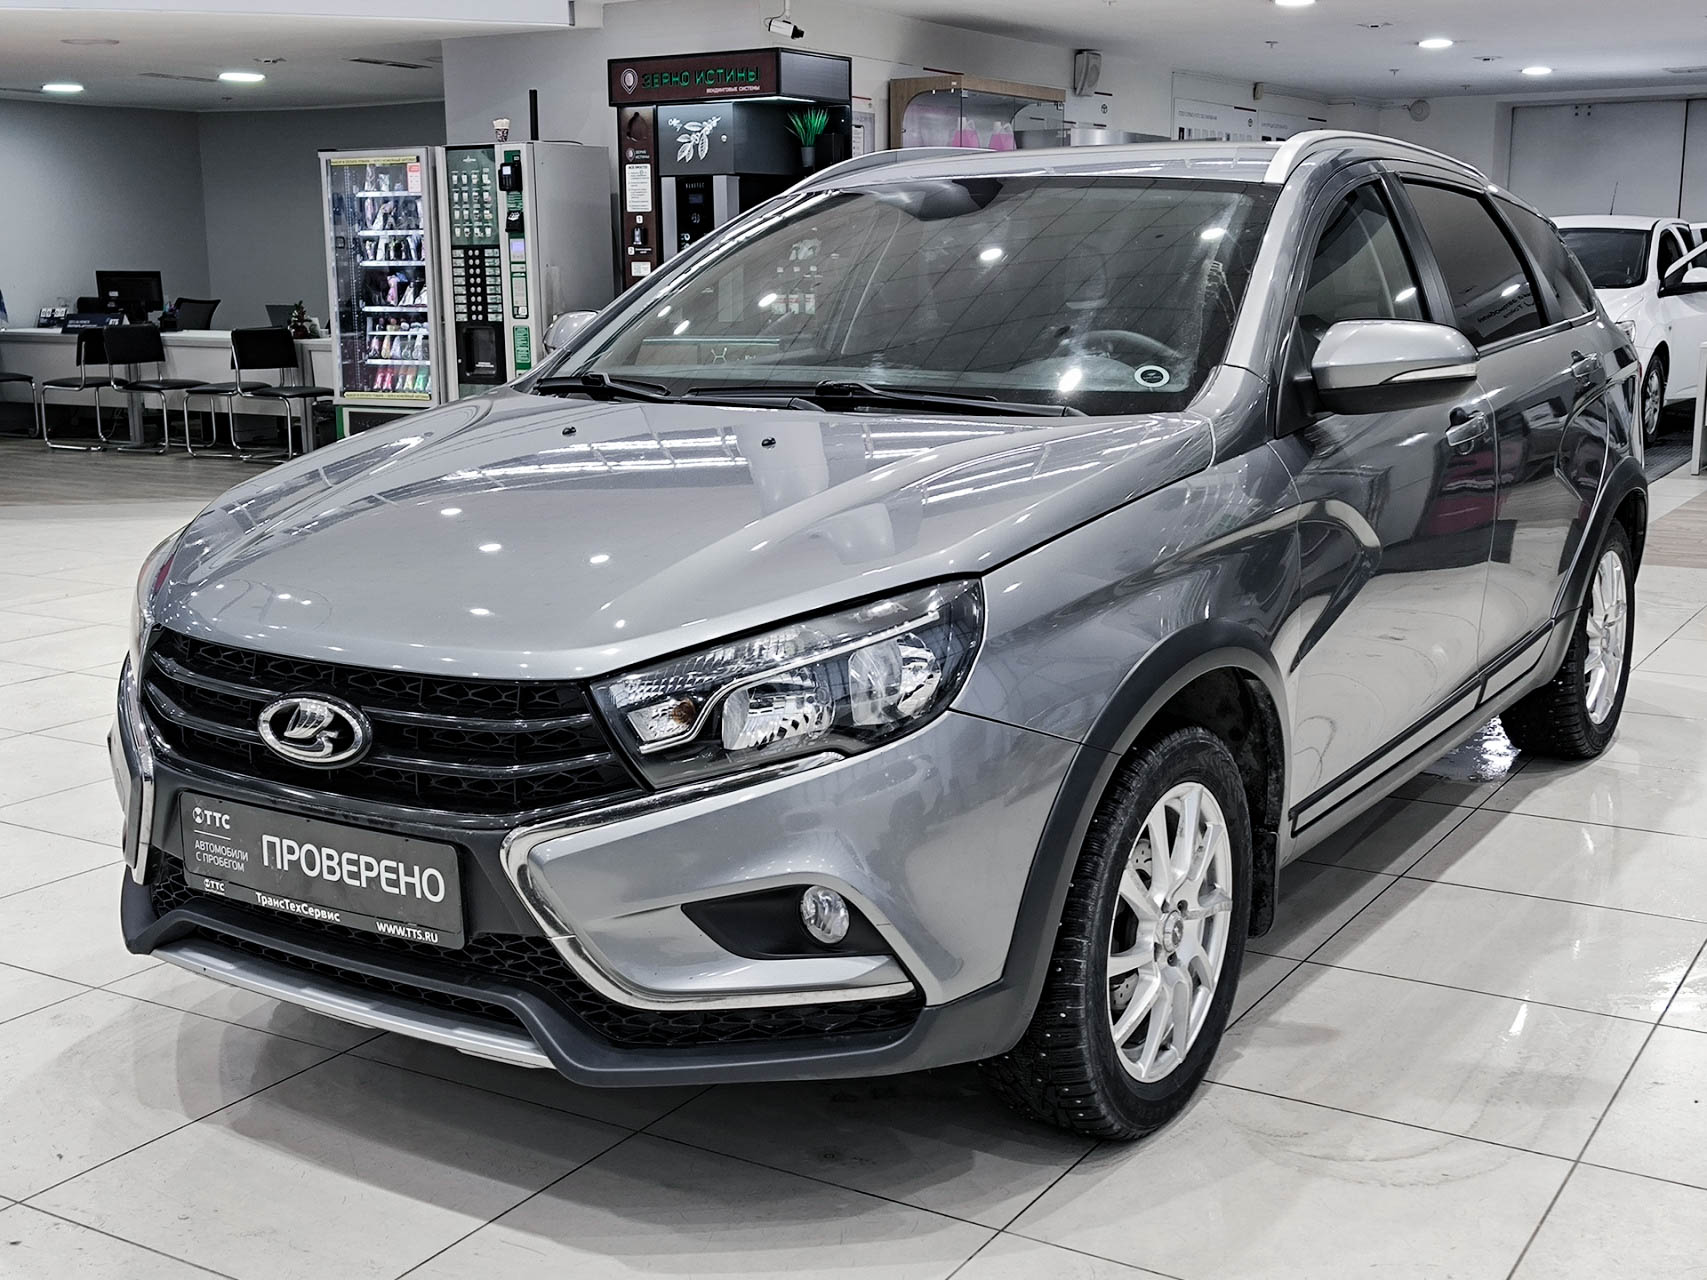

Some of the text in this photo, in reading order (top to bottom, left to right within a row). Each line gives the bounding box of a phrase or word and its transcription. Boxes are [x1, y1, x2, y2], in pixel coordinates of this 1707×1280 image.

[642, 66, 760, 88] ЗЕРНО ИСТИНЫ
[204, 809, 231, 830] ТТС
[194, 839, 249, 862] АВТОМОБИЛИ
[196, 851, 245, 873] С ПРОБЕГОМ
[261, 833, 446, 903] ПРОВЕРЕНО
[209, 879, 225, 892] ТТС
[255, 891, 341, 922] ТрансТехСервис
[376, 921, 439, 943] WWW.TTS.RU
